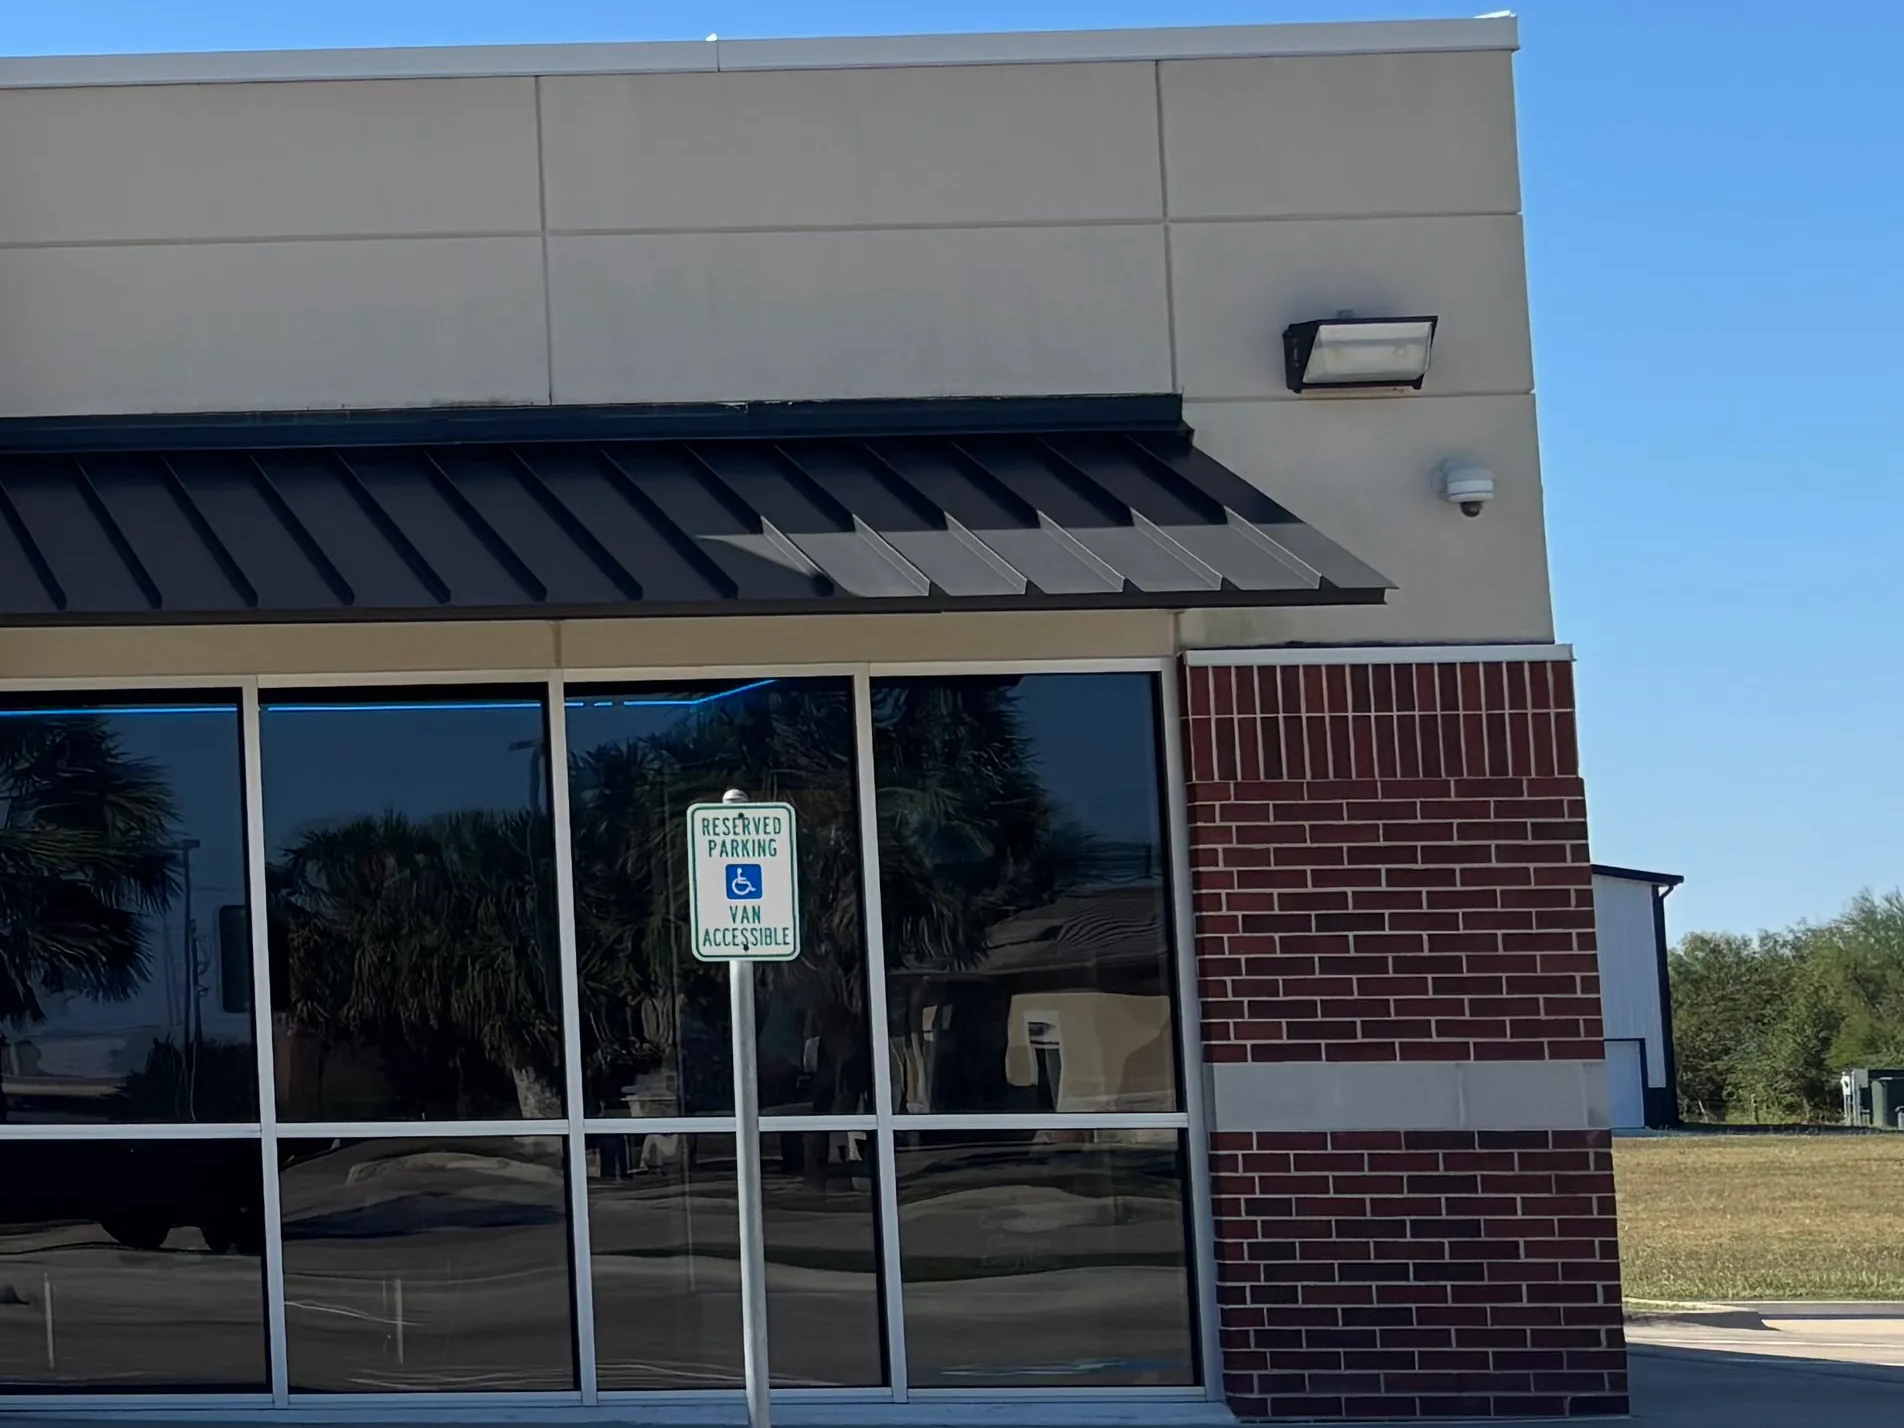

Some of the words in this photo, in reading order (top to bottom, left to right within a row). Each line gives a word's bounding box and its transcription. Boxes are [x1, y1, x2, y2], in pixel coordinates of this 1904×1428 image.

[702, 816, 782, 836] RESERVED
[708, 838, 777, 858] PARKING
[729, 905, 761, 924] VAN
[703, 927, 791, 947] ACCESSIBLE
